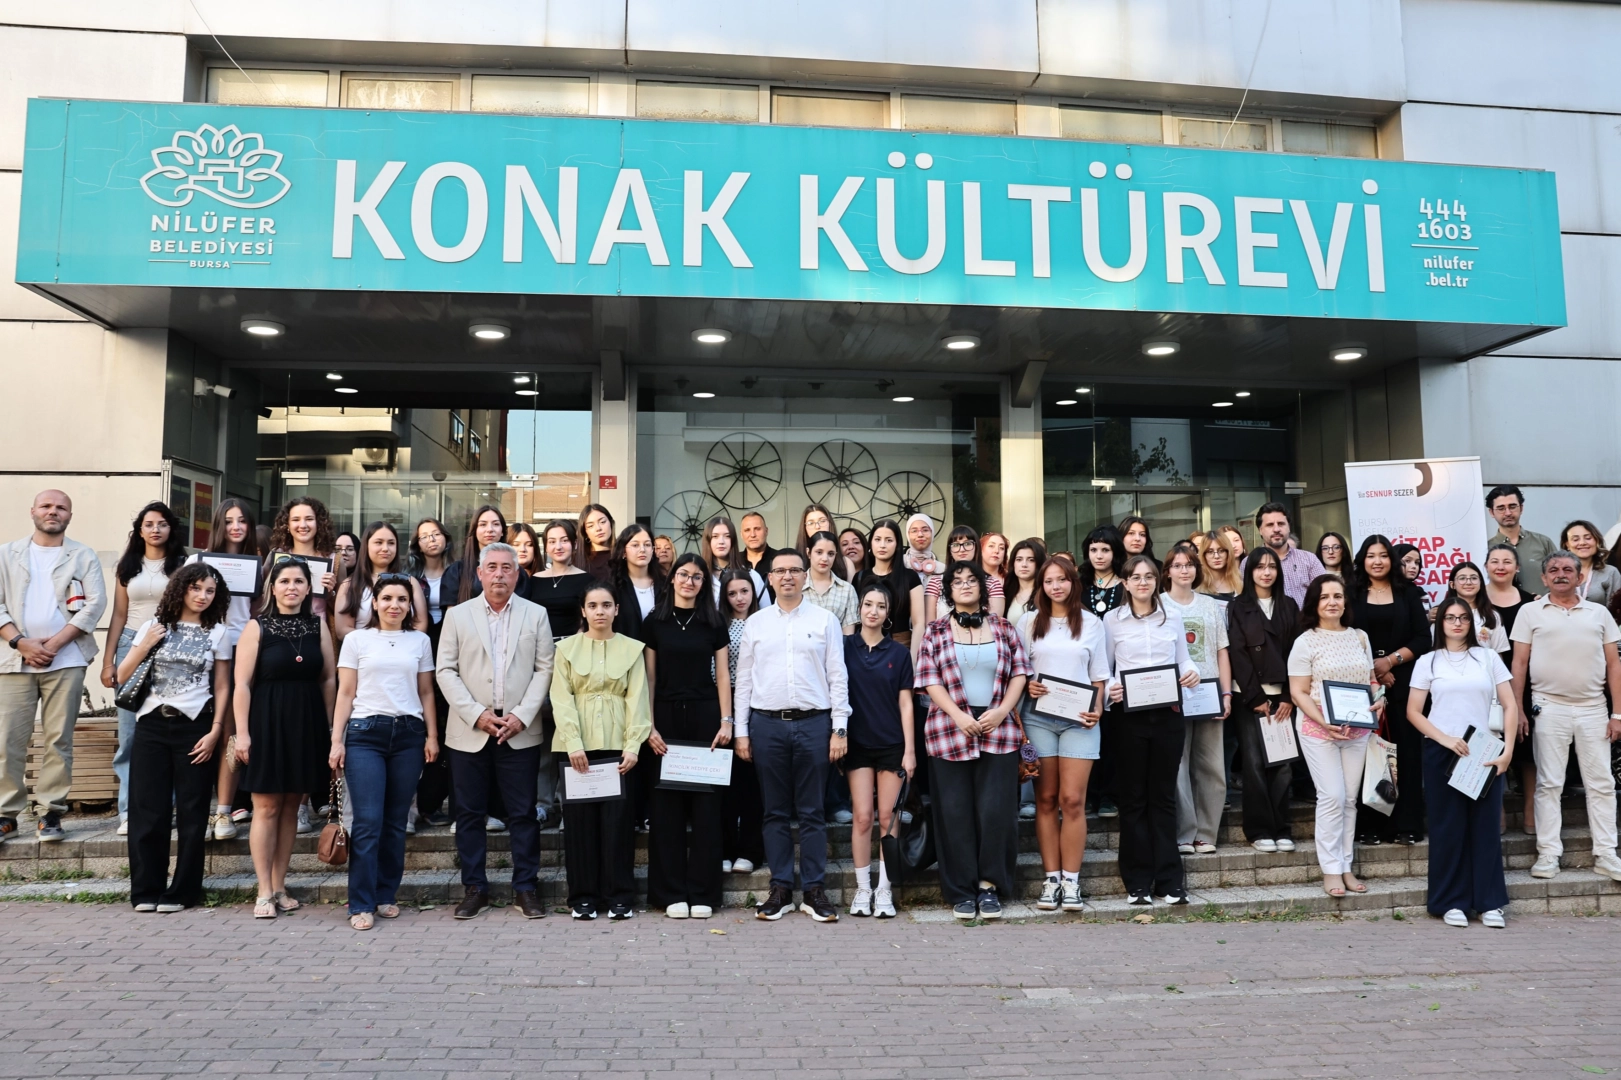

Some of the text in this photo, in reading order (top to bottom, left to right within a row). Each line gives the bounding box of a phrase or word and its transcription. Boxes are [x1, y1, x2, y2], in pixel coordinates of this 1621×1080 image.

[1419, 198, 1467, 221] 444
[151, 210, 276, 235] NİLÜFER
[331, 152, 1386, 292] KONAK KÜLTÜREVİ
[1417, 218, 1472, 240] 1603
[149, 237, 273, 255] BELEDİYESİ
[189, 259, 231, 269] BURSA
[1423, 255, 1474, 271] nilufer
[1425, 272, 1469, 288] .bel.tr
[1366, 489, 1393, 498] SENNUR
[1393, 488, 1414, 497] SEZER
[1358, 517, 1388, 527] BURSA
